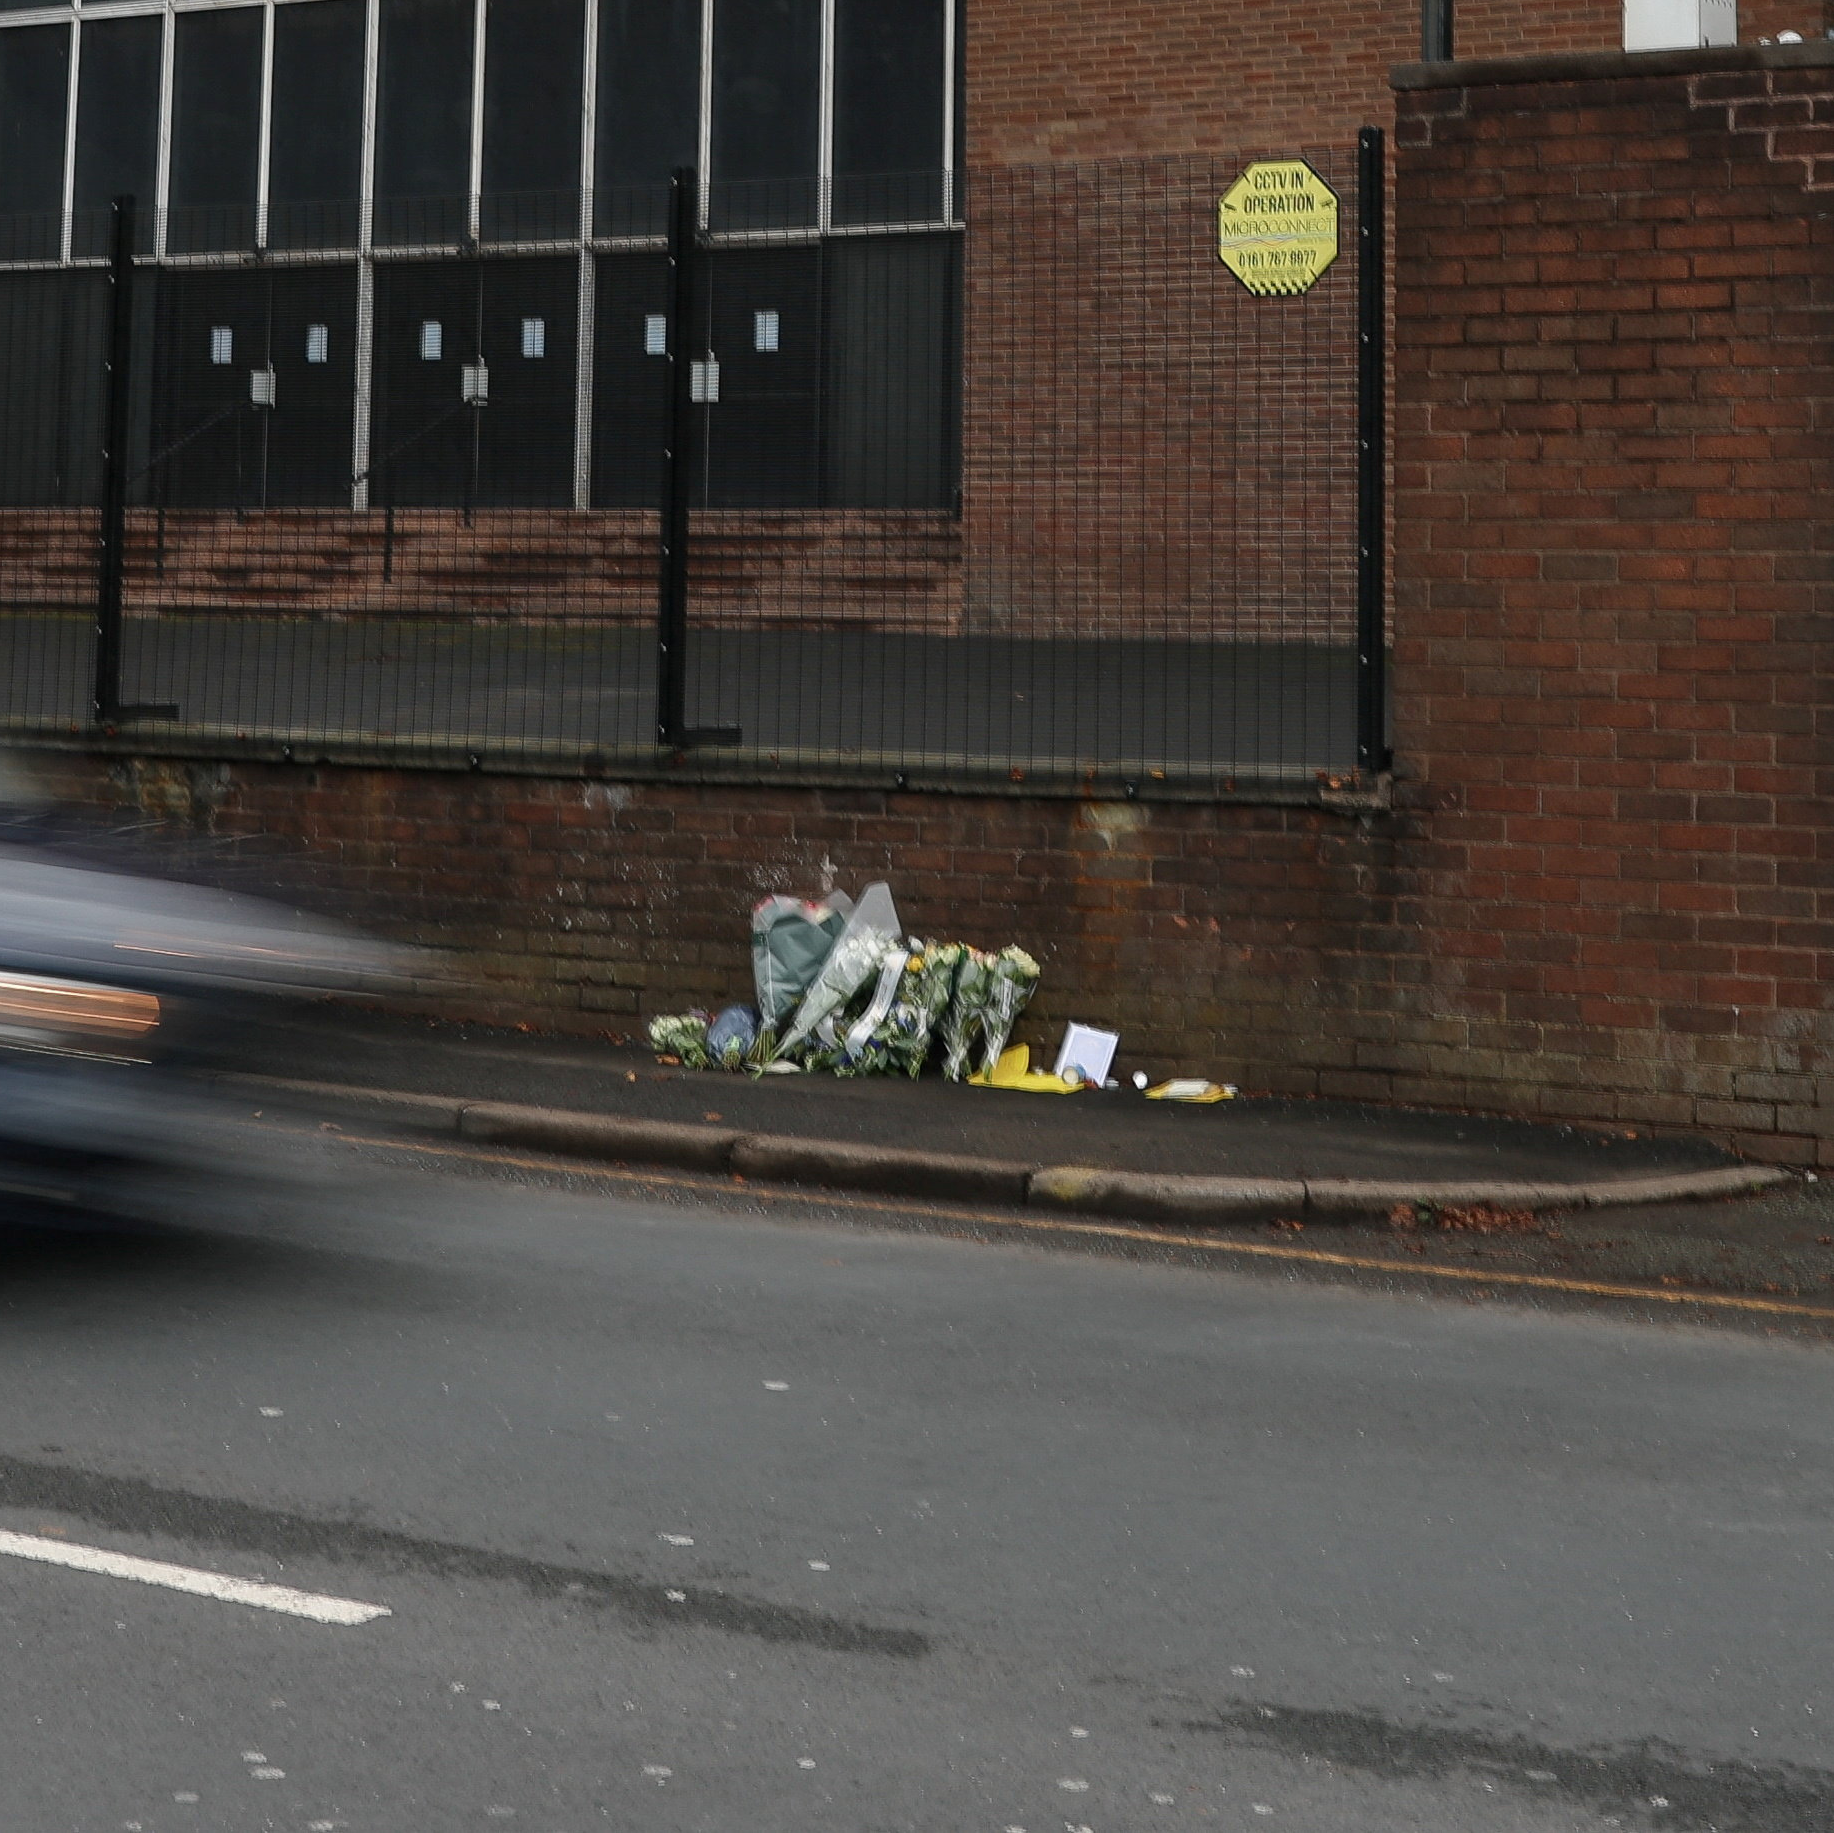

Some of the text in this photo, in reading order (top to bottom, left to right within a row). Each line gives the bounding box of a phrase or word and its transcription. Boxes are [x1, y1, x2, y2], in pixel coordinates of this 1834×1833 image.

[1254, 169, 1304, 190] CCTV IN
[1243, 194, 1315, 214] OPERATION
[1223, 218, 1335, 238] MICROCONNECT
[1239, 251, 1265, 269] 0161
